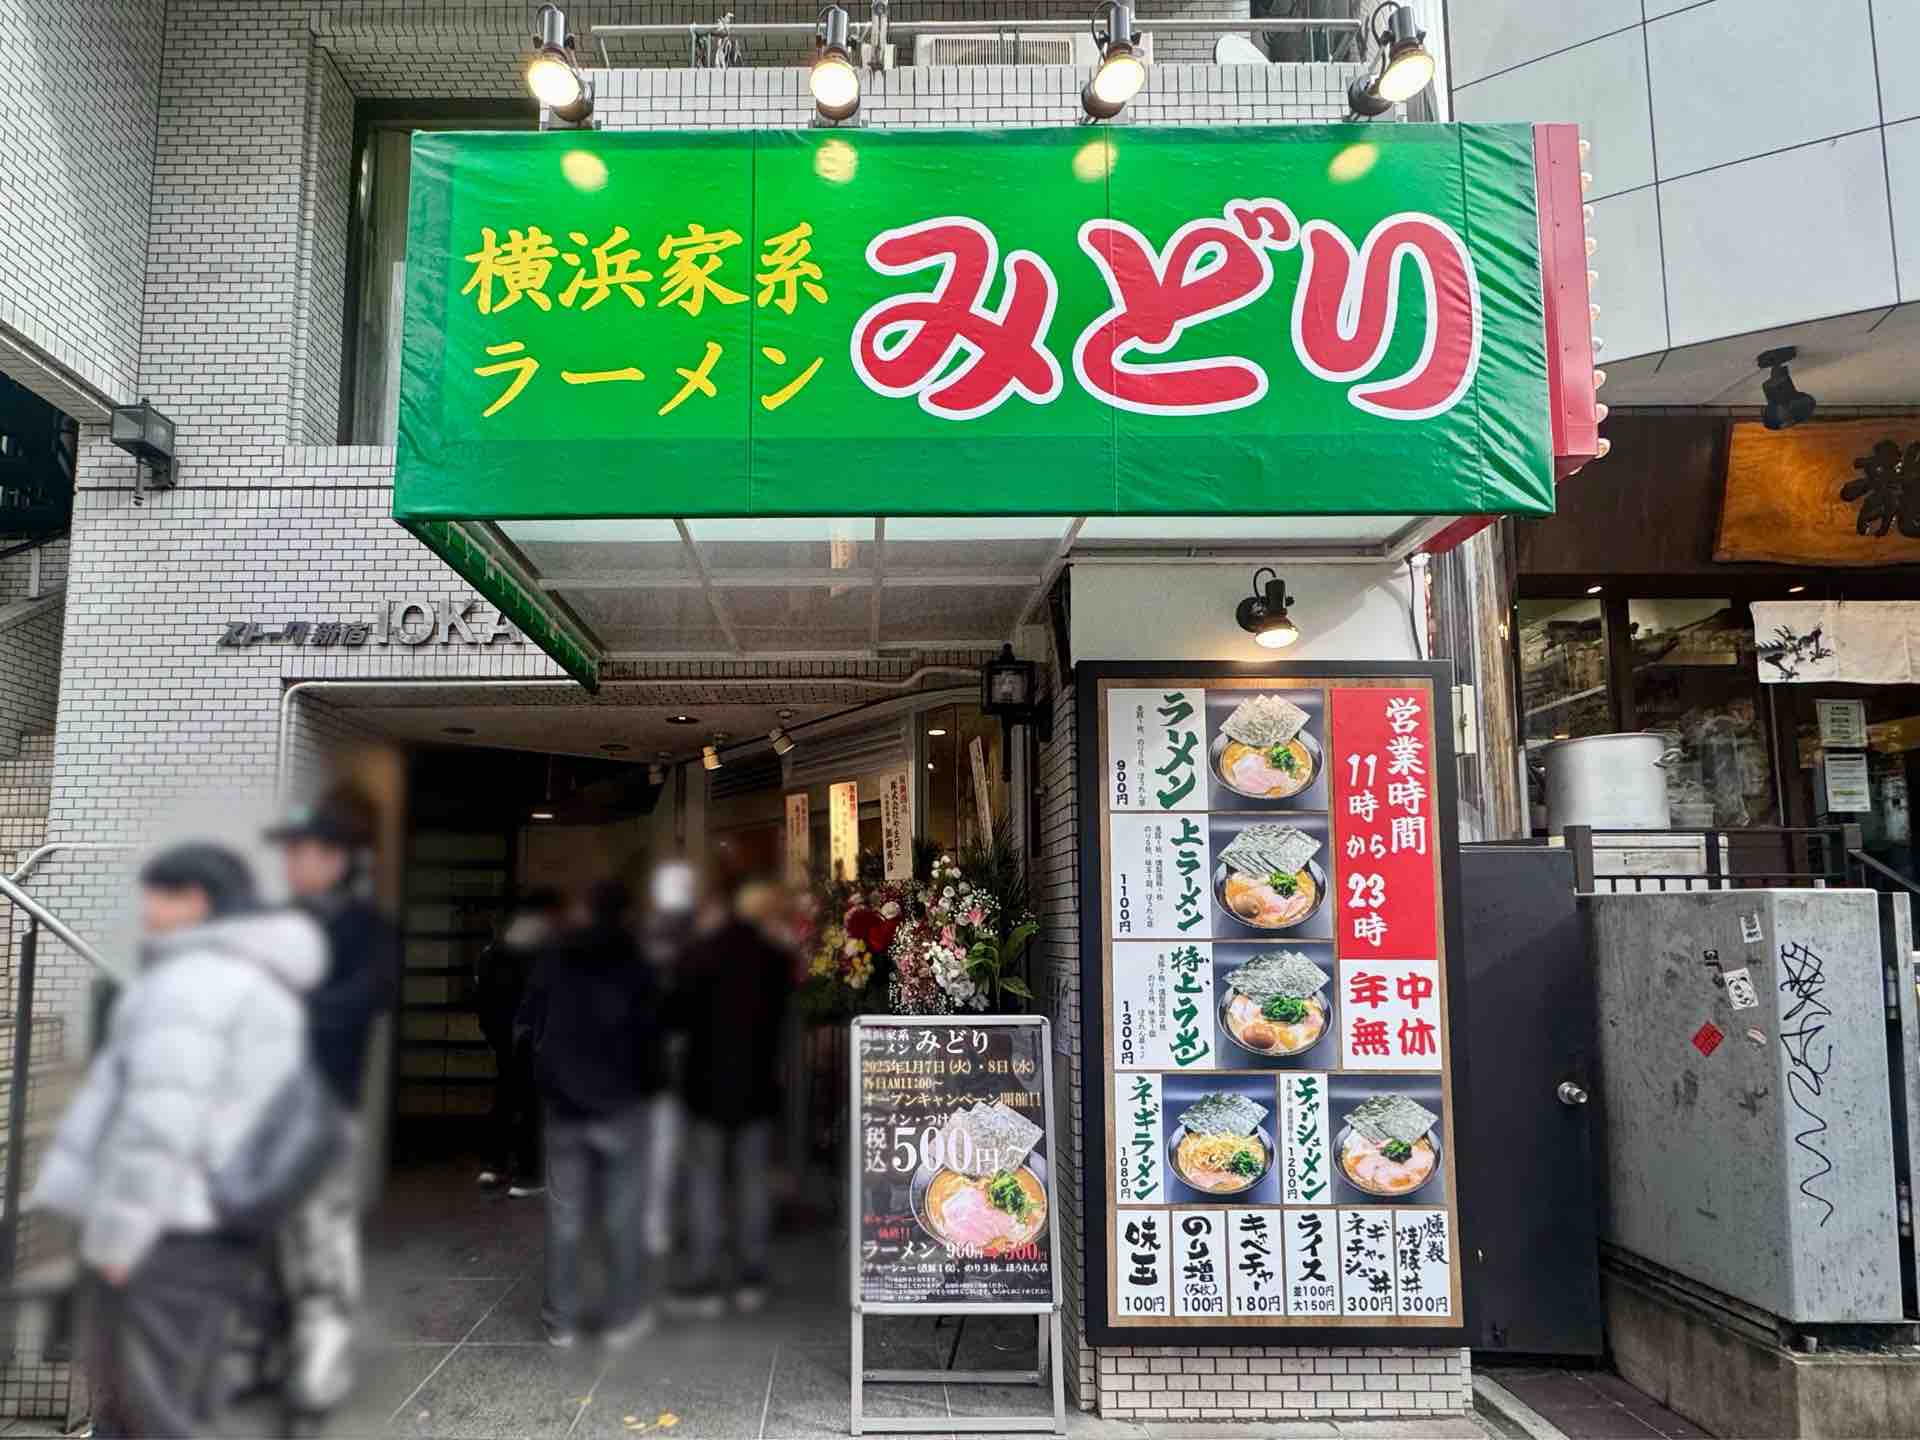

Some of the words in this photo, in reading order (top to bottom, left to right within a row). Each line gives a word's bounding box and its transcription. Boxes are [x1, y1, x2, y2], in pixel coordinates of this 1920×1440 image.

[461, 222, 829, 317] 横浜家系
[850, 197, 1482, 421] みどり
[474, 341, 825, 417] ラーメン
[1154, 692, 1199, 809] ラーメン
[1386, 697, 1428, 855] 営業時間
[1116, 760, 1128, 805] 900円
[1170, 817, 1204, 931] 上ラーメン
[1119, 873, 1131, 933] 1100円
[916, 1029, 988, 1054] みどり
[1121, 1001, 1134, 1064] 1300円
[865, 1127, 888, 1173] 税込
[1128, 1076, 1159, 1200] ネギラーメン
[1295, 1076, 1327, 1201] チャーシューメン
[1120, 1147, 1131, 1199] 1080円
[1287, 1147, 1298, 1199] 1200円
[862, 1241, 937, 1260] ラーメン
[1125, 1216, 1161, 1285] 味玉
[1182, 1215, 1214, 1282] のり増
[1297, 1213, 1326, 1281] ライス
[1125, 1296, 1165, 1312] 100円
[1182, 1297, 1223, 1312] 100円
[1236, 1296, 1280, 1312] 180円
[1294, 1285, 1334, 1297] 並100円
[1294, 1300, 1335, 1311] 大150円
[1347, 1297, 1392, 1312] 300円
[1402, 1297, 1448, 1312] 300円
